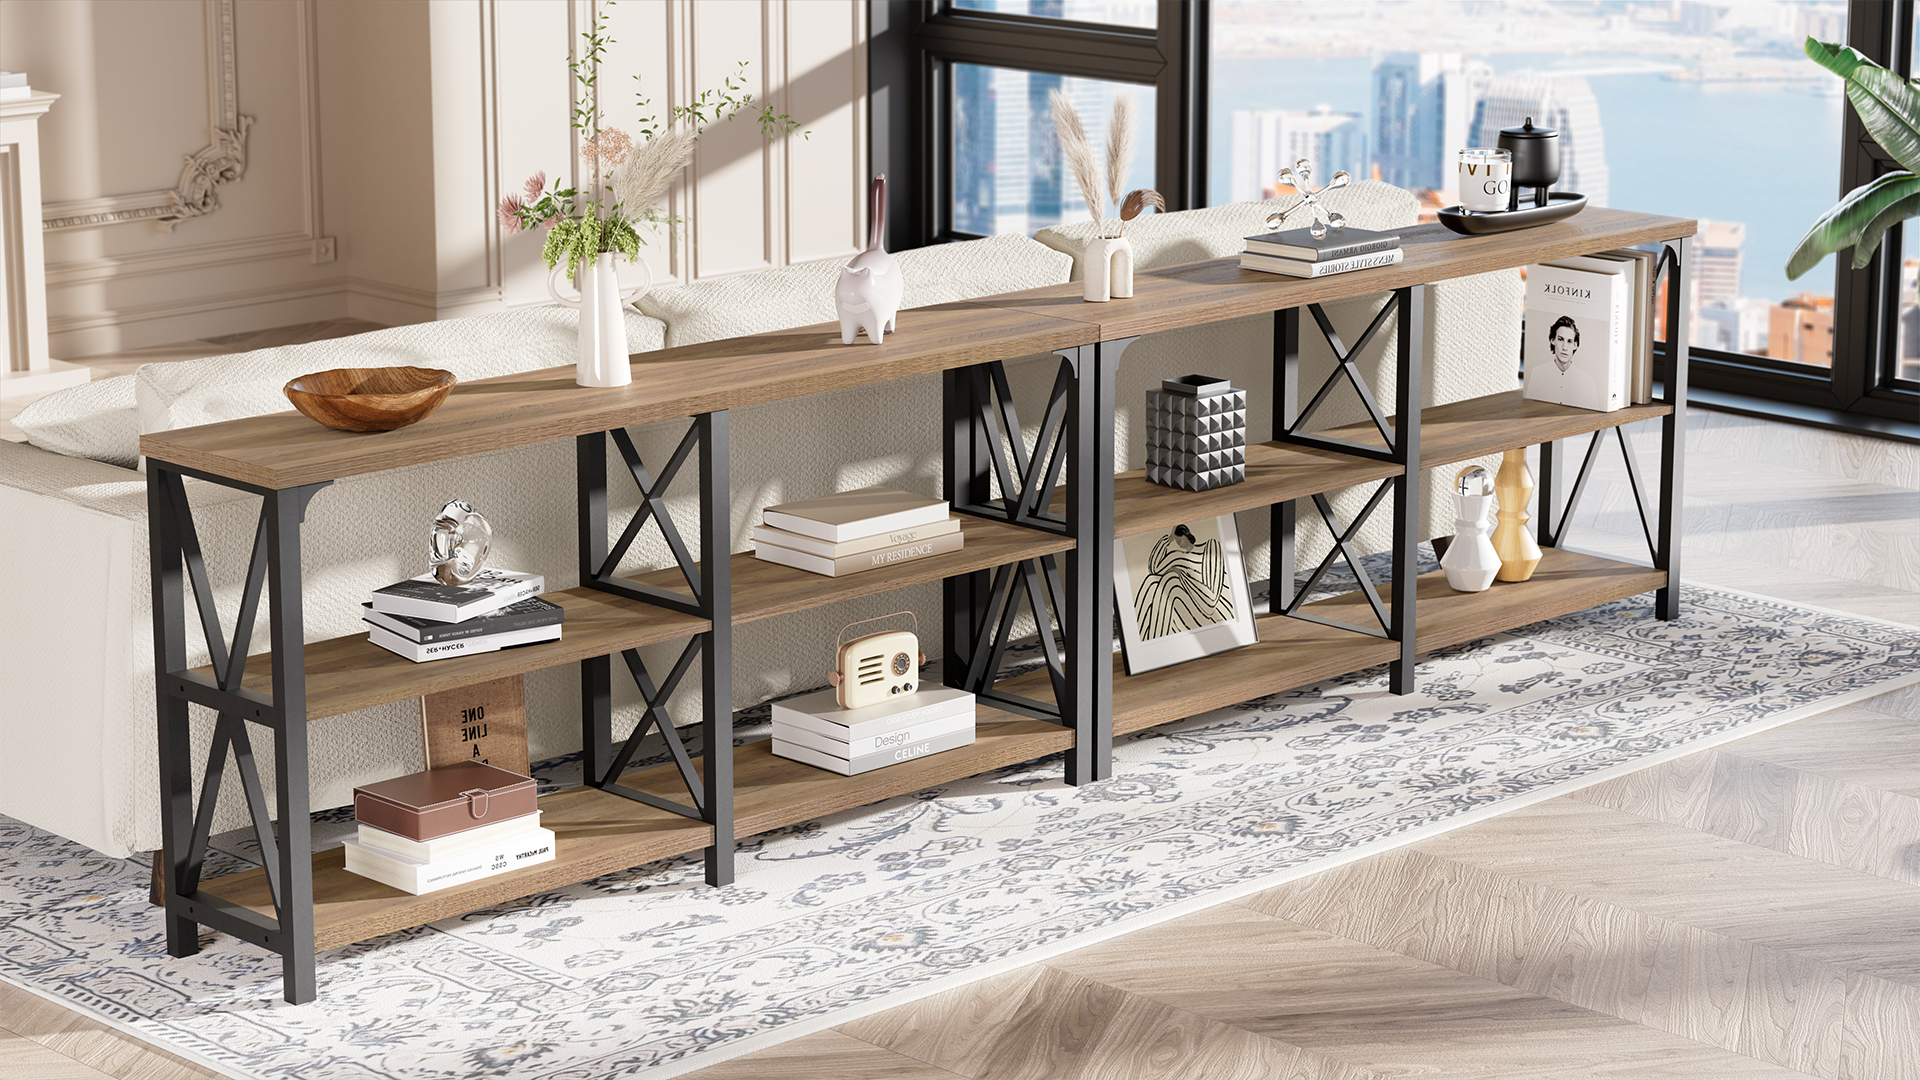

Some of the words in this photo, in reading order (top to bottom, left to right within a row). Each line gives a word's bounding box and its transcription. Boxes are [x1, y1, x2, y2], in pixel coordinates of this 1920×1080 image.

[1483, 180, 1510, 196] GO
[889, 531, 917, 544] Voyage
[872, 553, 886, 566] MY
[886, 543, 933, 563] RESIDENCE
[886, 715, 902, 725] CASE
[902, 711, 920, 721] STUDY
[920, 705, 944, 717] HOUSES
[875, 732, 911, 749] Design
[895, 743, 930, 760] CELINE
